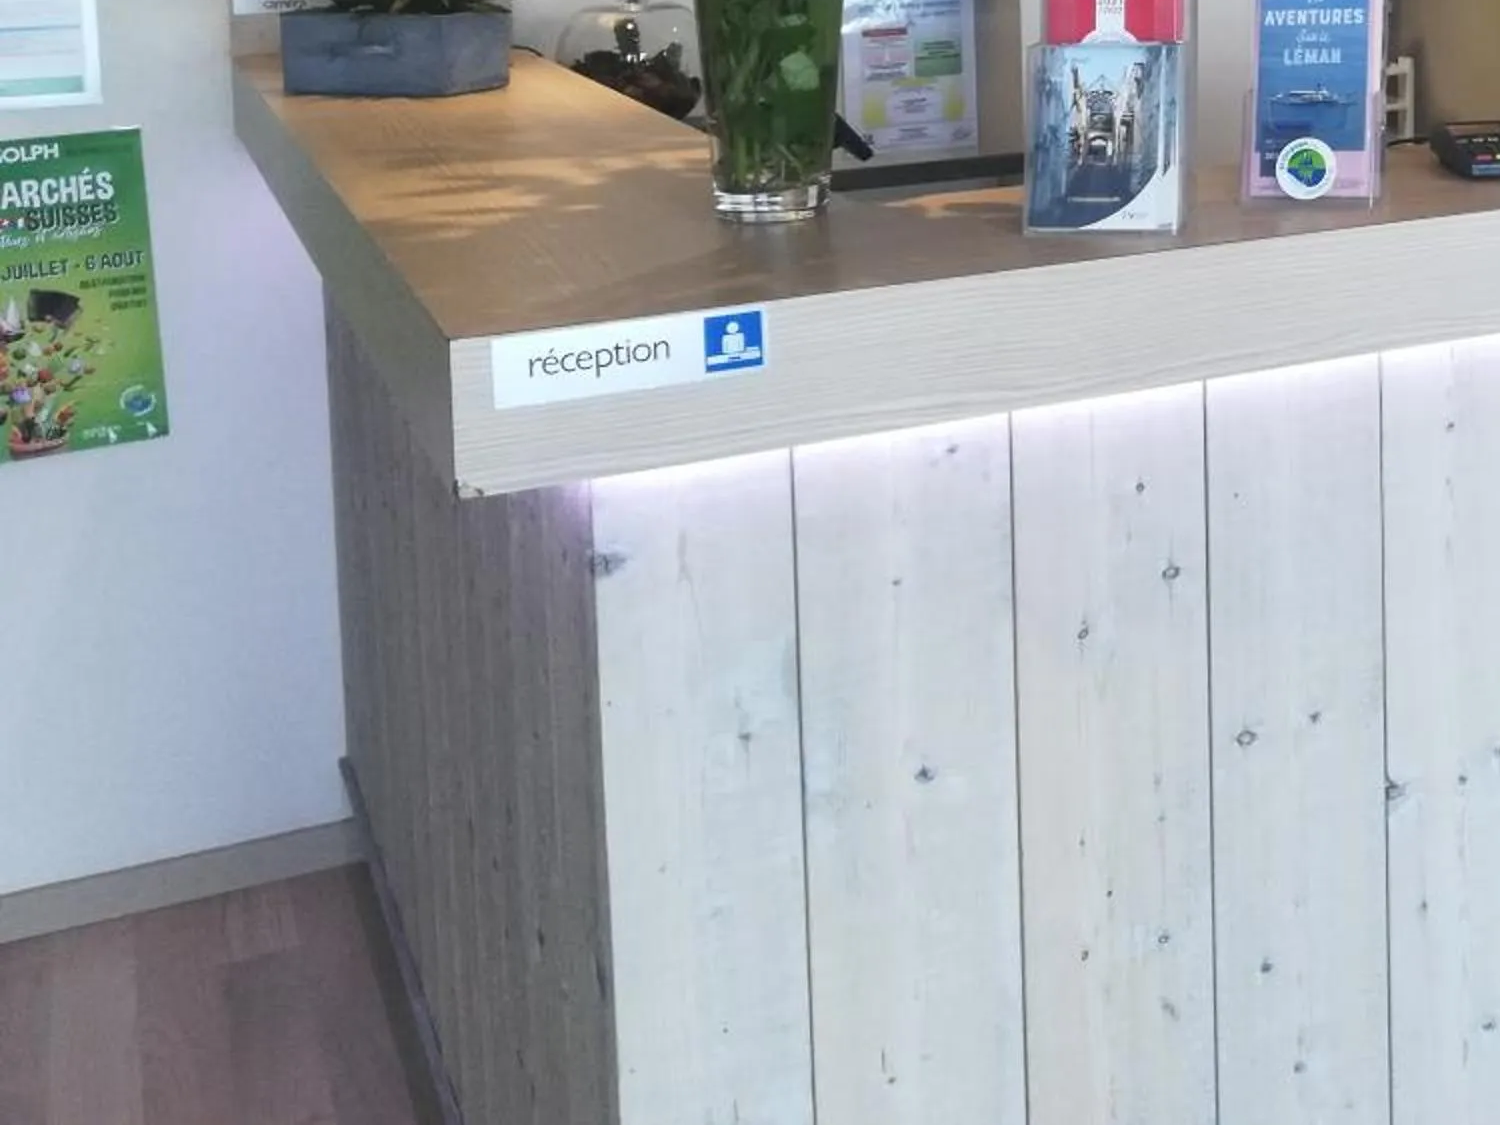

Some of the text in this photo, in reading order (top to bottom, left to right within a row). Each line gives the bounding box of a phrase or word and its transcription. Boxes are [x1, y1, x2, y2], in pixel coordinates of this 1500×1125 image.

[1263, 7, 1365, 26] AVENTURES
[0, 142, 60, 164] OLPH
[0, 167, 115, 210] ARCHÉS
[25, 202, 121, 232] SUISSES
[3, 258, 70, 281] JUILLET
[100, 250, 145, 271] AOUT
[528, 337, 671, 378] réception
